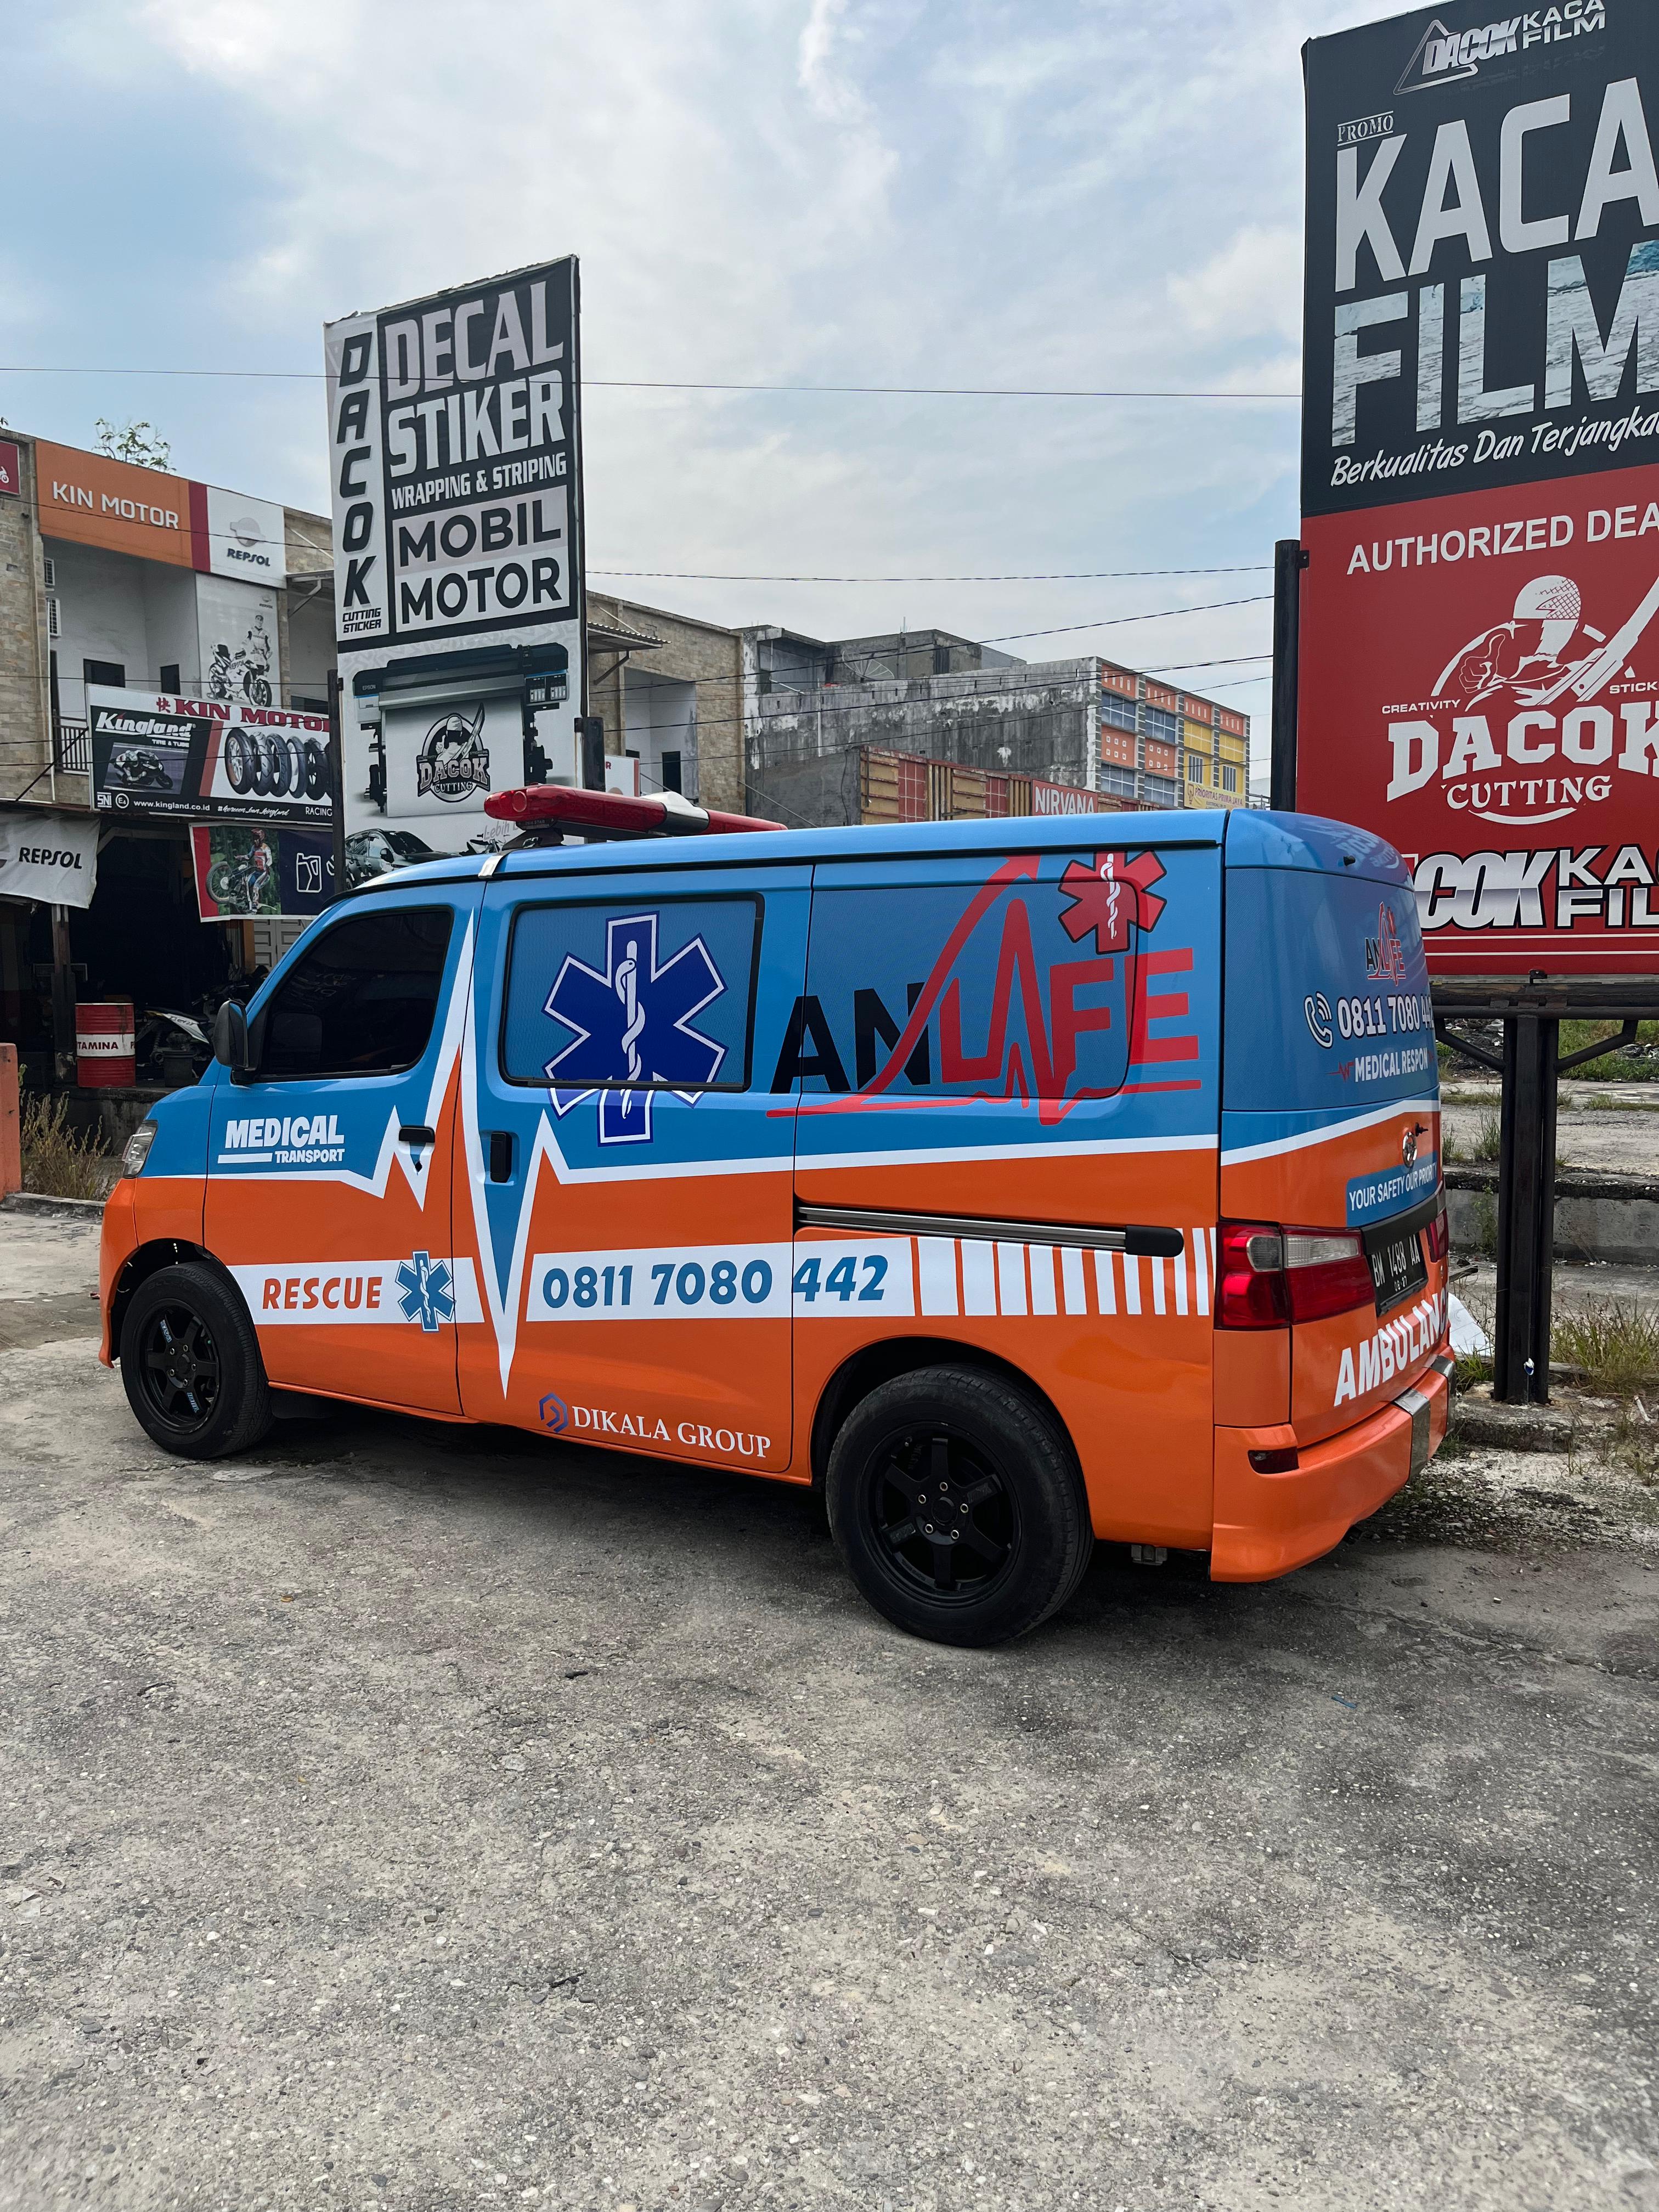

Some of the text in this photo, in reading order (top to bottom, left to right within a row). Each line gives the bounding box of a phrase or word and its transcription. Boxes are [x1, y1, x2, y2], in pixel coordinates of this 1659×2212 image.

[1523, 0, 1605, 31] KACA
[1523, 11, 1605, 49] FILM
[1422, 16, 1523, 75] DACOK
[1338, 114, 1394, 142] PROMO
[1335, 77, 1659, 292] KACA
[383, 280, 565, 403] DECAL
[1331, 239, 1659, 447] FILM
[387, 369, 566, 478] STIKER
[336, 331, 376, 607] DACOK
[1330, 438, 1468, 487] Berkualitas
[1472, 430, 1524, 463] Dan
[391, 452, 567, 510] WRAPPING & STRIPING
[52, 481, 179, 529] KIN MOTOR
[399, 499, 561, 567] MOBIL
[1347, 515, 1574, 575] AUTHORIZED
[227, 548, 270, 567] REPSOL
[400, 557, 563, 624] MOTOR
[342, 607, 381, 623] CUTTING
[343, 619, 382, 634] STICKER
[174, 698, 231, 721] KIN
[1382, 699, 1462, 714] CREATIVITY
[95, 712, 193, 738] Kingland
[1387, 701, 1659, 802] DACOK
[419, 758, 488, 790] DACOK
[434, 781, 473, 793] CUTTING
[97, 794, 111, 806] SNI
[133, 800, 210, 811] www.kingland.co.id
[1035, 786, 1094, 815] NIRVANA
[1446, 775, 1612, 810] CUTTING
[305, 806, 332, 816] RACING
[484, 821, 510, 840] Lebih
[19, 847, 82, 869] REPSOL
[1414, 850, 1558, 929] COK
[1558, 845, 1659, 887] KA
[1338, 997, 1387, 1037] 0811
[1387, 995, 1420, 1032] 7080
[77, 1042, 119, 1050] TAMINA
[1355, 1047, 1427, 1082] MEDICAL RESPON
[225, 1115, 345, 1148] MEDICAL
[275, 1148, 345, 1164] TRANSPORT
[1349, 1188, 1376, 1211] YOUR
[1378, 1176, 1404, 1203] SAFETY
[1406, 1171, 1418, 1192] OUR
[1372, 1251, 1385, 1288] BM
[1409, 1234, 1421, 1266] AA
[262, 1276, 382, 1310] RESCUE
[542, 1255, 889, 1309] 0811 7080 442
[1333, 1287, 1449, 1407] AMBULANC
[572, 1404, 771, 1458] DIKALA GROUP
